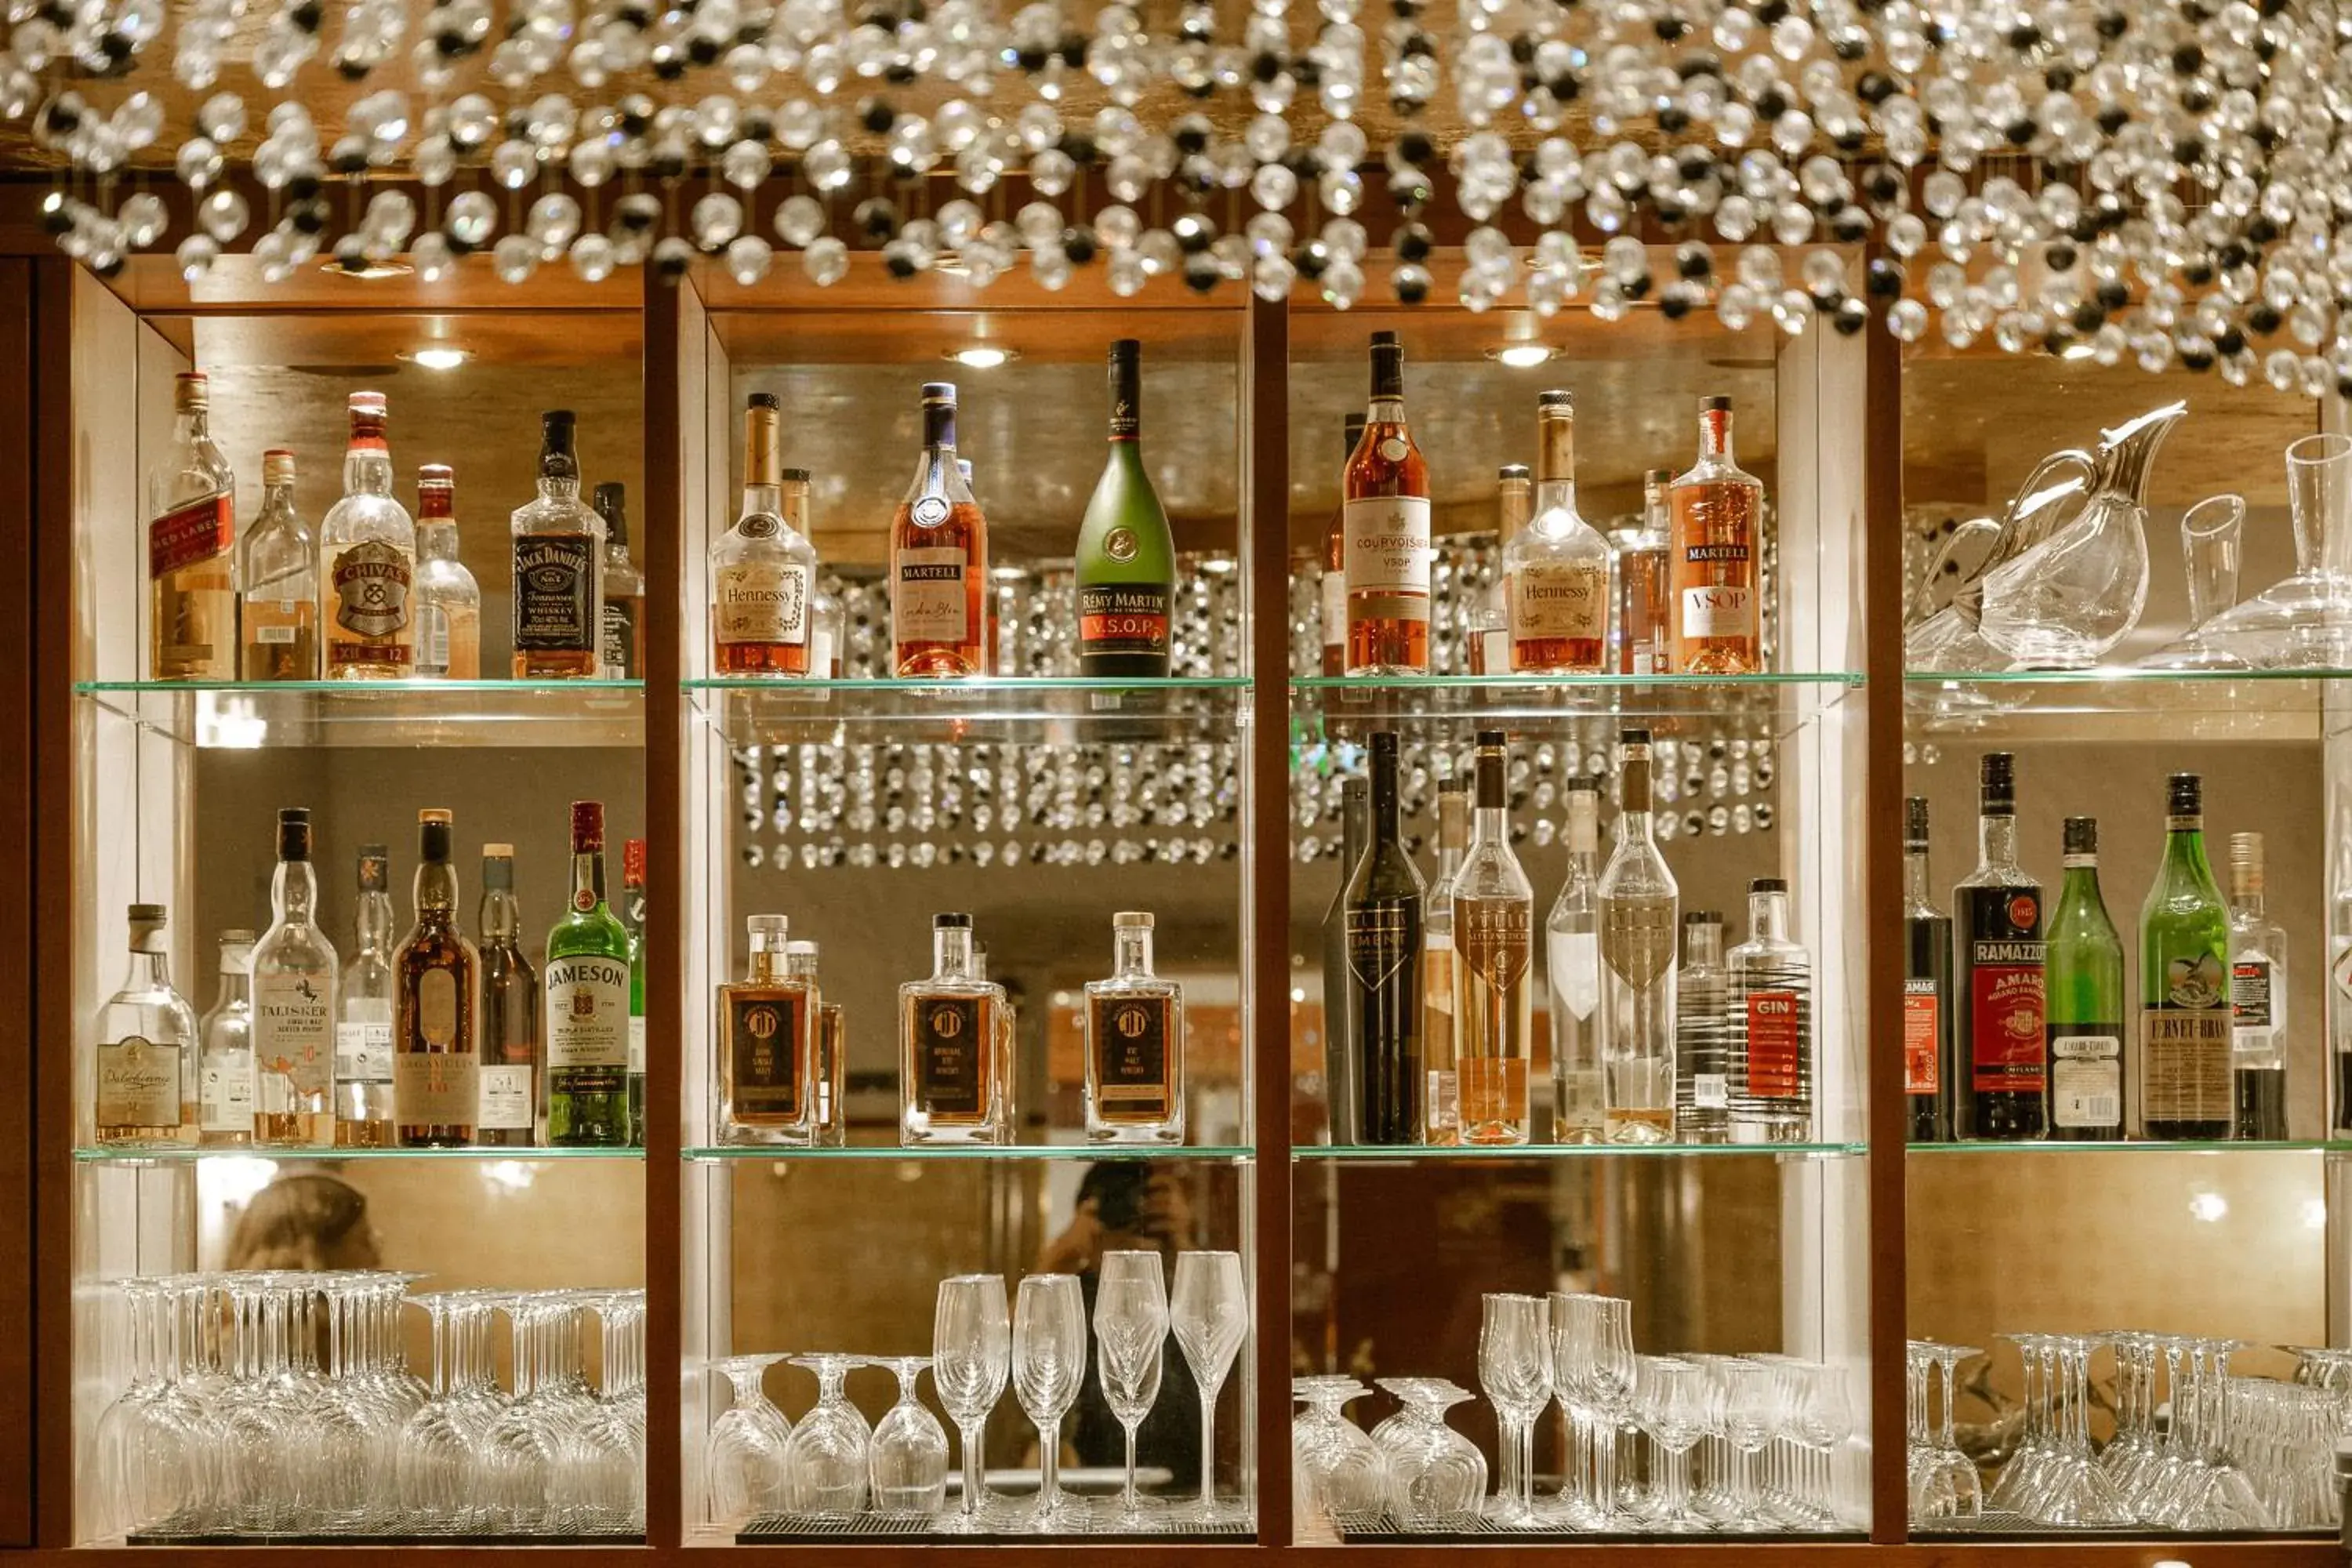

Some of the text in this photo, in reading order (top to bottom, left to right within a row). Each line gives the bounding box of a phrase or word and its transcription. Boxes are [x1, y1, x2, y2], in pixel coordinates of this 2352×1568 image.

[180, 518, 223, 541] LABEL
[1690, 547, 1745, 560] MARTELL
[517, 551, 544, 572] JACK
[1383, 557, 1410, 567] VSOP
[344, 564, 402, 581] CHIVAS
[904, 567, 957, 578] MARTELL
[728, 588, 791, 603] Hennessy
[1116, 592, 1163, 609] MARTIN
[1526, 585, 1590, 601] Hennessy
[1693, 592, 1746, 609] VSOP
[389, 648, 402, 661] 12
[549, 965, 623, 989] JAMESON
[261, 1006, 327, 1017] TALISKER
[1757, 1001, 1789, 1014] GIN
